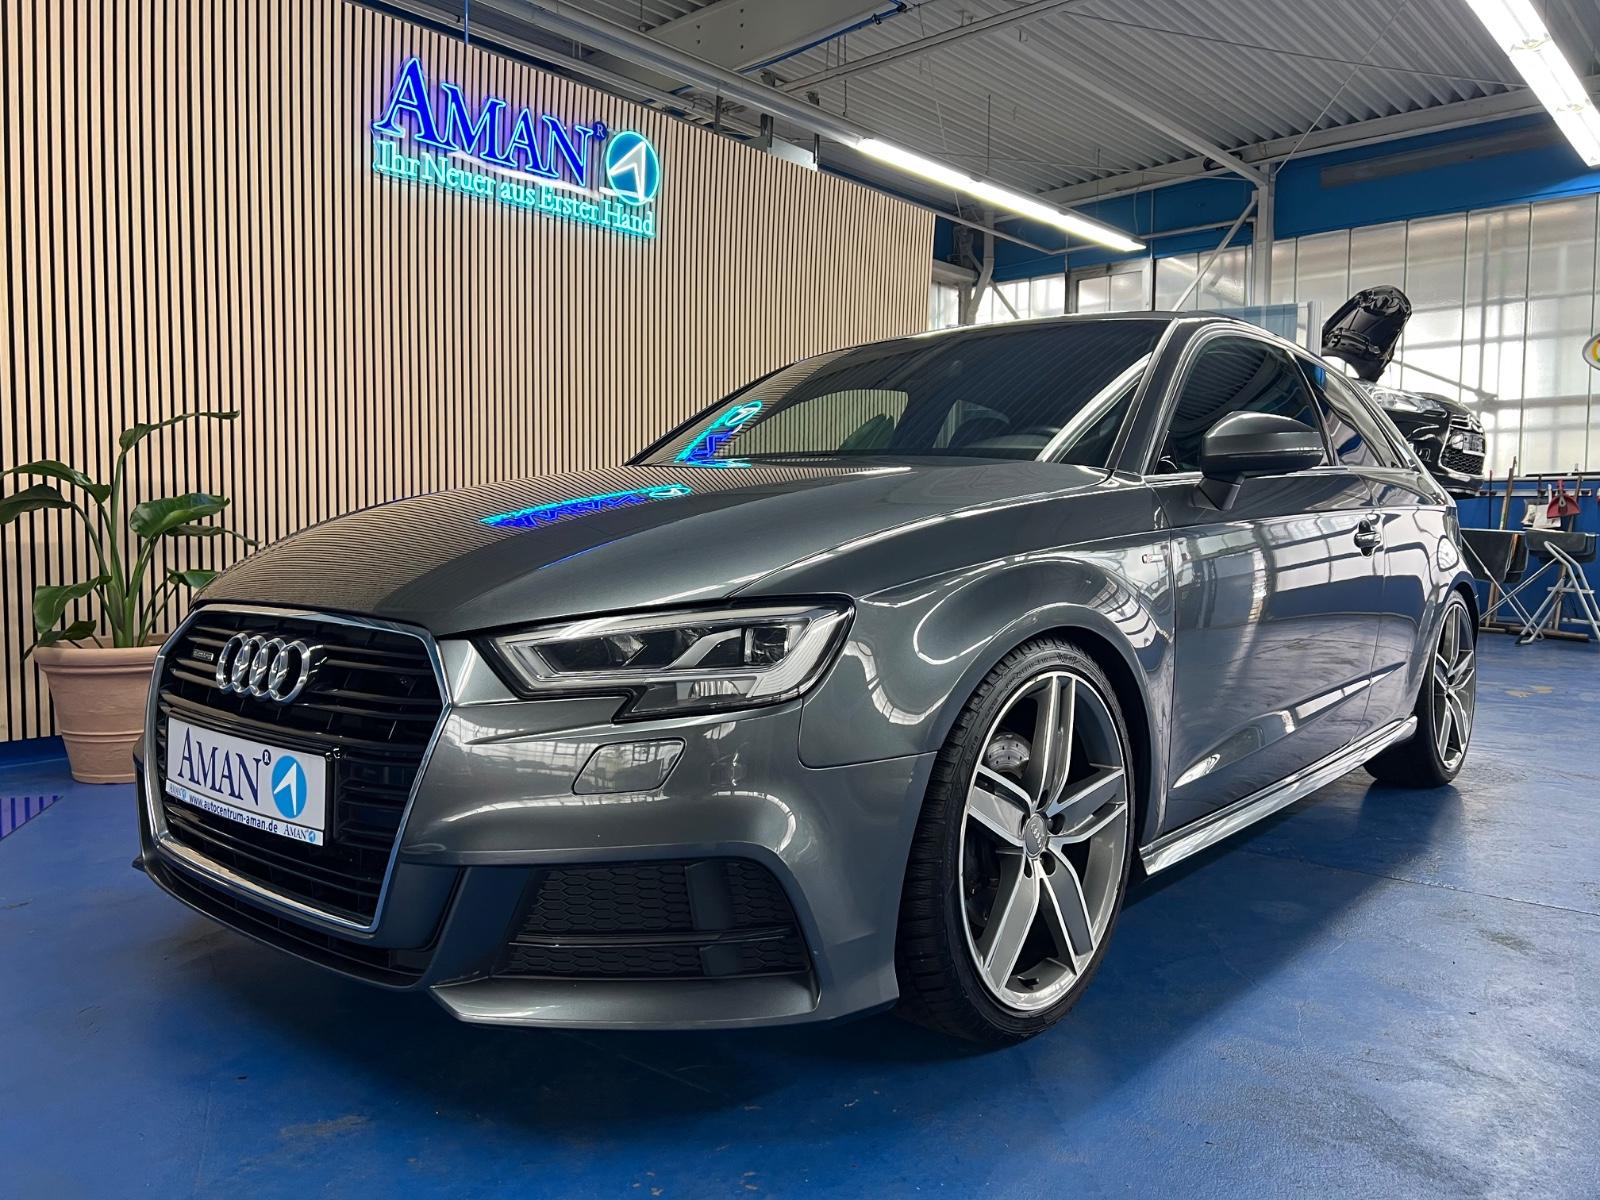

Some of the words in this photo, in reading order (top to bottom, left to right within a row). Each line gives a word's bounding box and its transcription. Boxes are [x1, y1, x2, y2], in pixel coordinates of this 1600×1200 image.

[376, 140, 420, 177] Ihr
[421, 151, 496, 196] Neuer
[500, 182, 536, 206] aus
[538, 183, 600, 221] Erster
[601, 199, 655, 236] Hand
[189, 794, 278, 833] www.autocentrum-aman.de
